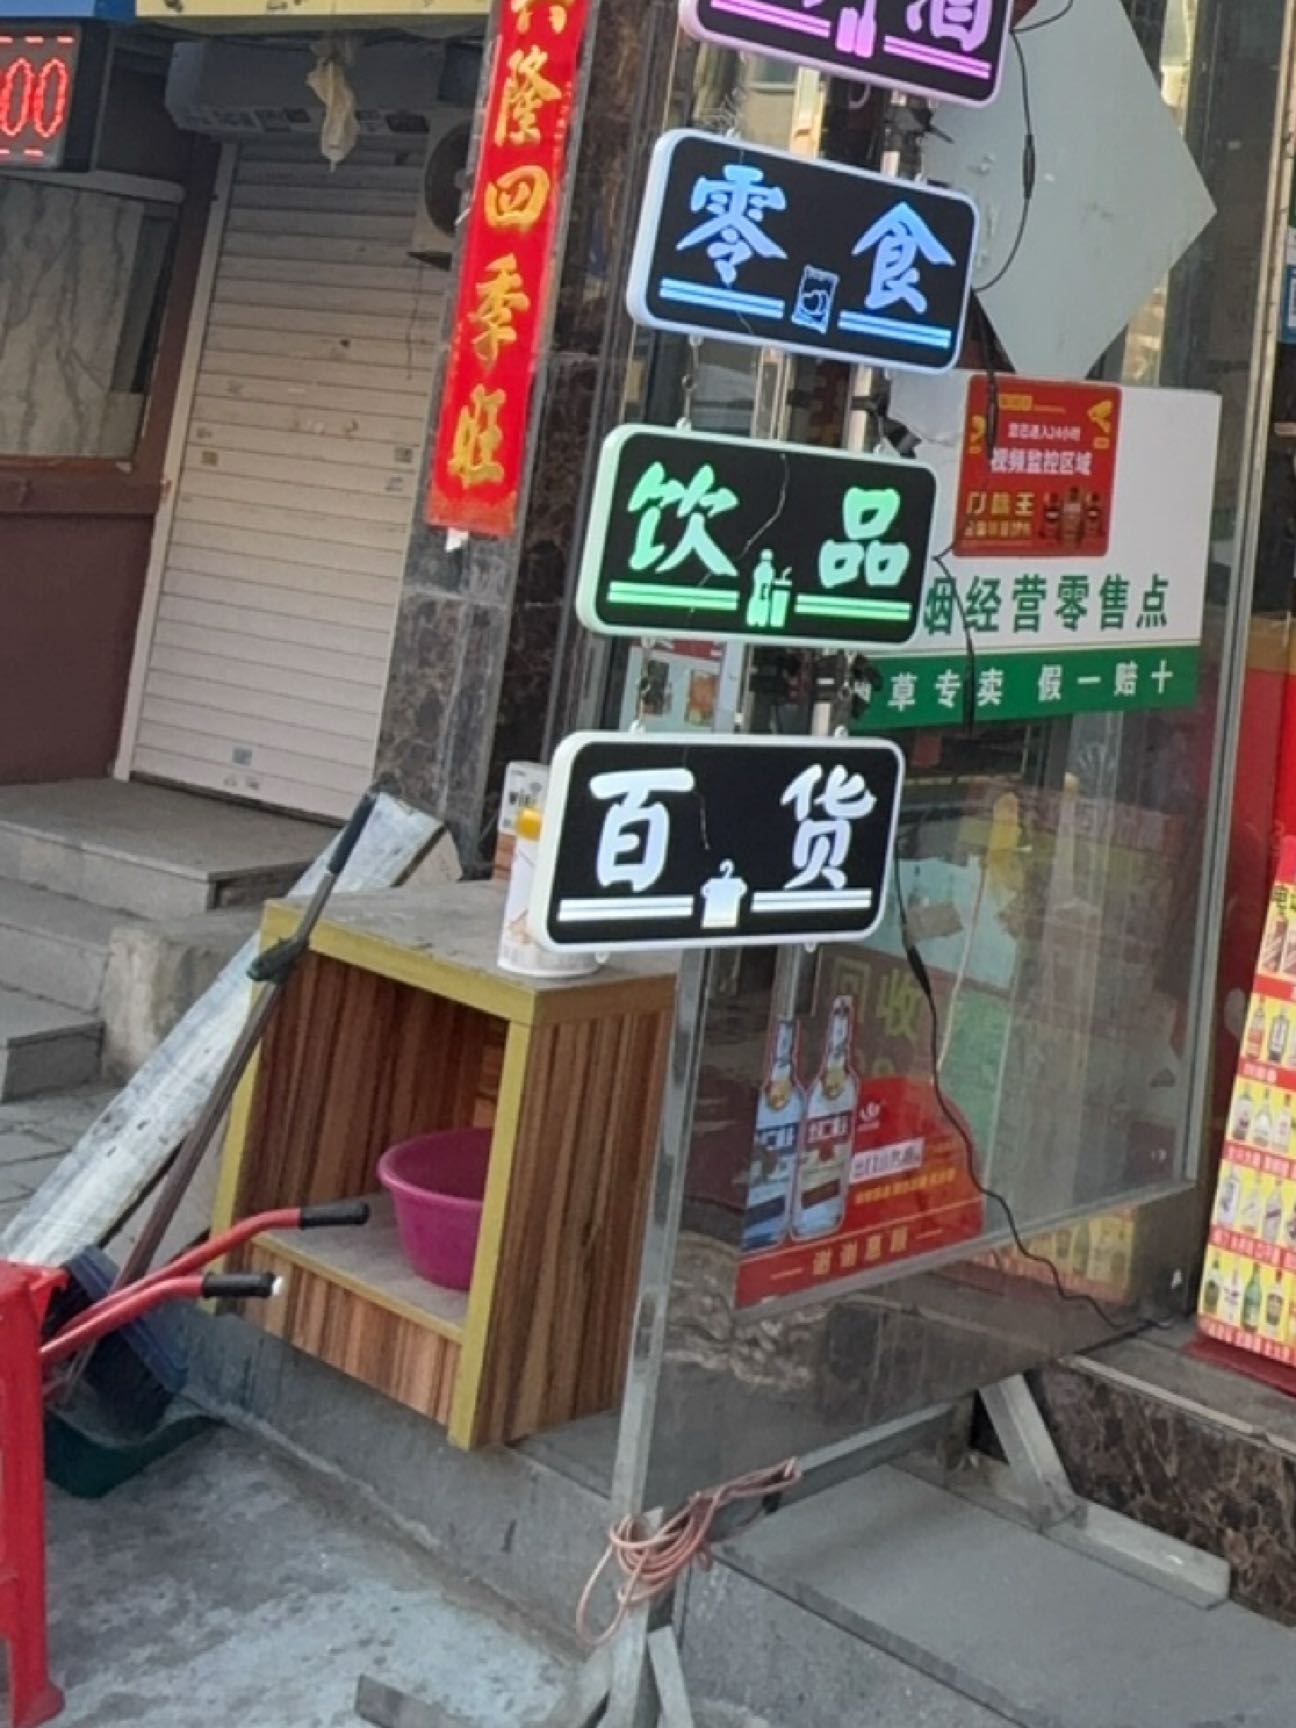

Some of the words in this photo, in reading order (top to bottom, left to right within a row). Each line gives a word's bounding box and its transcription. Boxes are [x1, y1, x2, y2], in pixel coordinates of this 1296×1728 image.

[676, 164, 955, 314] 零食
[628, 461, 910, 588] 饮品
[990, 446, 1094, 477] 视频监控区域
[1037, 658, 1174, 702] 假一赔十
[589, 763, 878, 893] 百货
